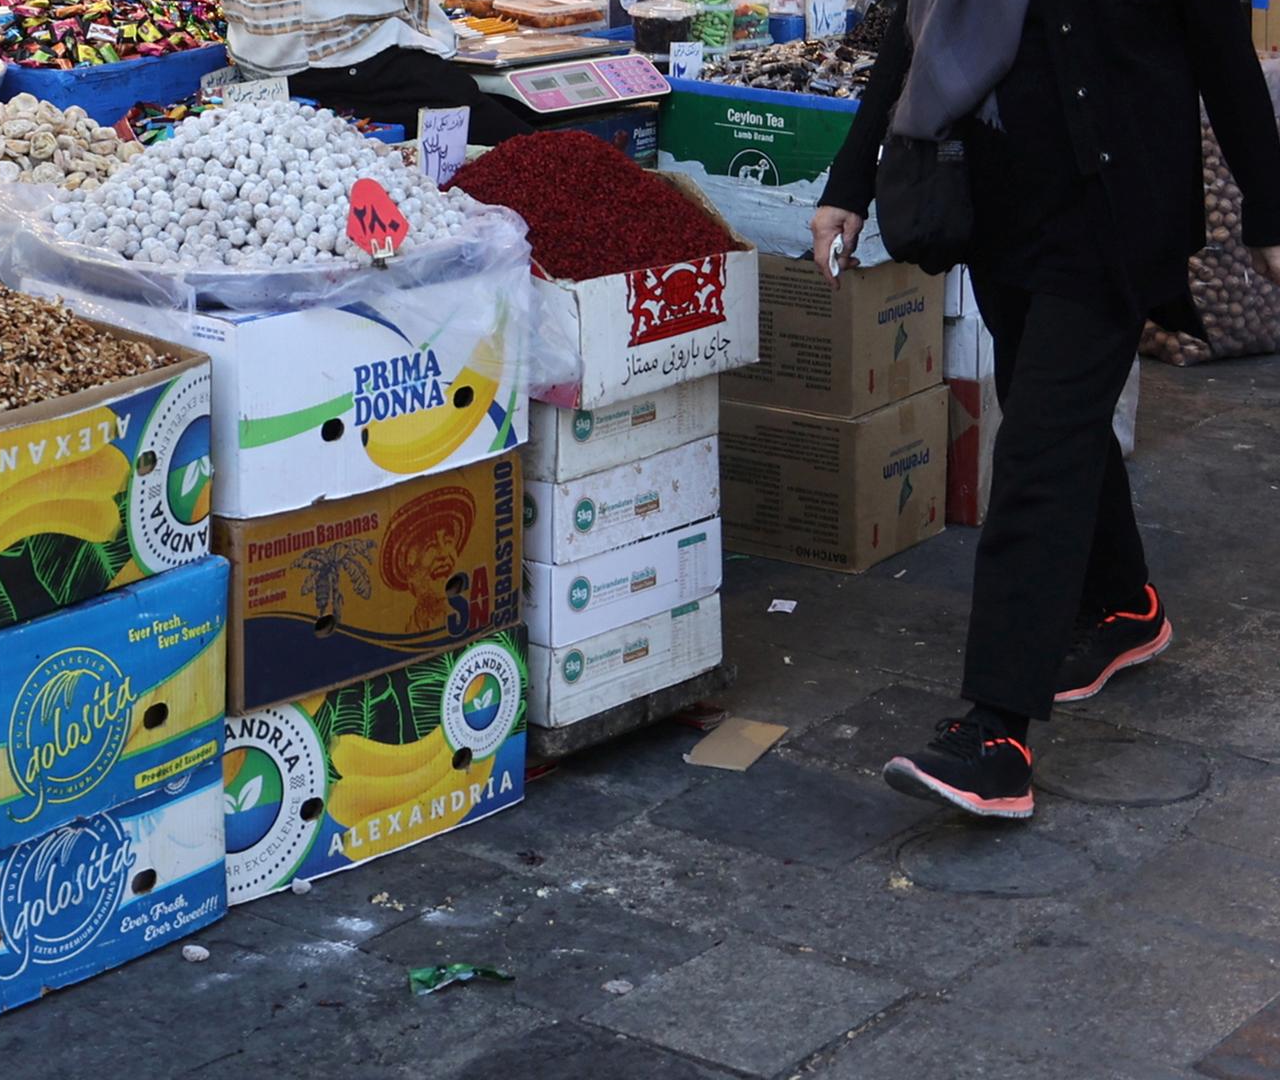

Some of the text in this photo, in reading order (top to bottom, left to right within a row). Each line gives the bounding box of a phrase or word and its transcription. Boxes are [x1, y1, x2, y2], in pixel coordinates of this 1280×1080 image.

[726, 107, 785, 129] Ceylon Tea
[733, 128, 753, 141] Lamb
[353, 203, 400, 236] ۲۸۰
[877, 295, 926, 325] Premium
[353, 348, 443, 397] PRIMA
[620, 352, 660, 387] ممتاز
[661, 336, 700, 375] باروتی
[353, 377, 446, 428] DONNA
[882, 447, 930, 480] Premium
[247, 511, 380, 564] Premium Bananas
[493, 459, 516, 628] SEBASTIANO
[127, 626, 152, 643] Ever
[157, 632, 180, 650] Ever
[141, 759, 172, 784] Product
[183, 745, 214, 769] Ecuador
[327, 770, 514, 858] ALEXANDRIA
[244, 794, 302, 875] EXCELLENCE
[119, 914, 151, 934] Ever
[143, 922, 172, 942] Ever
